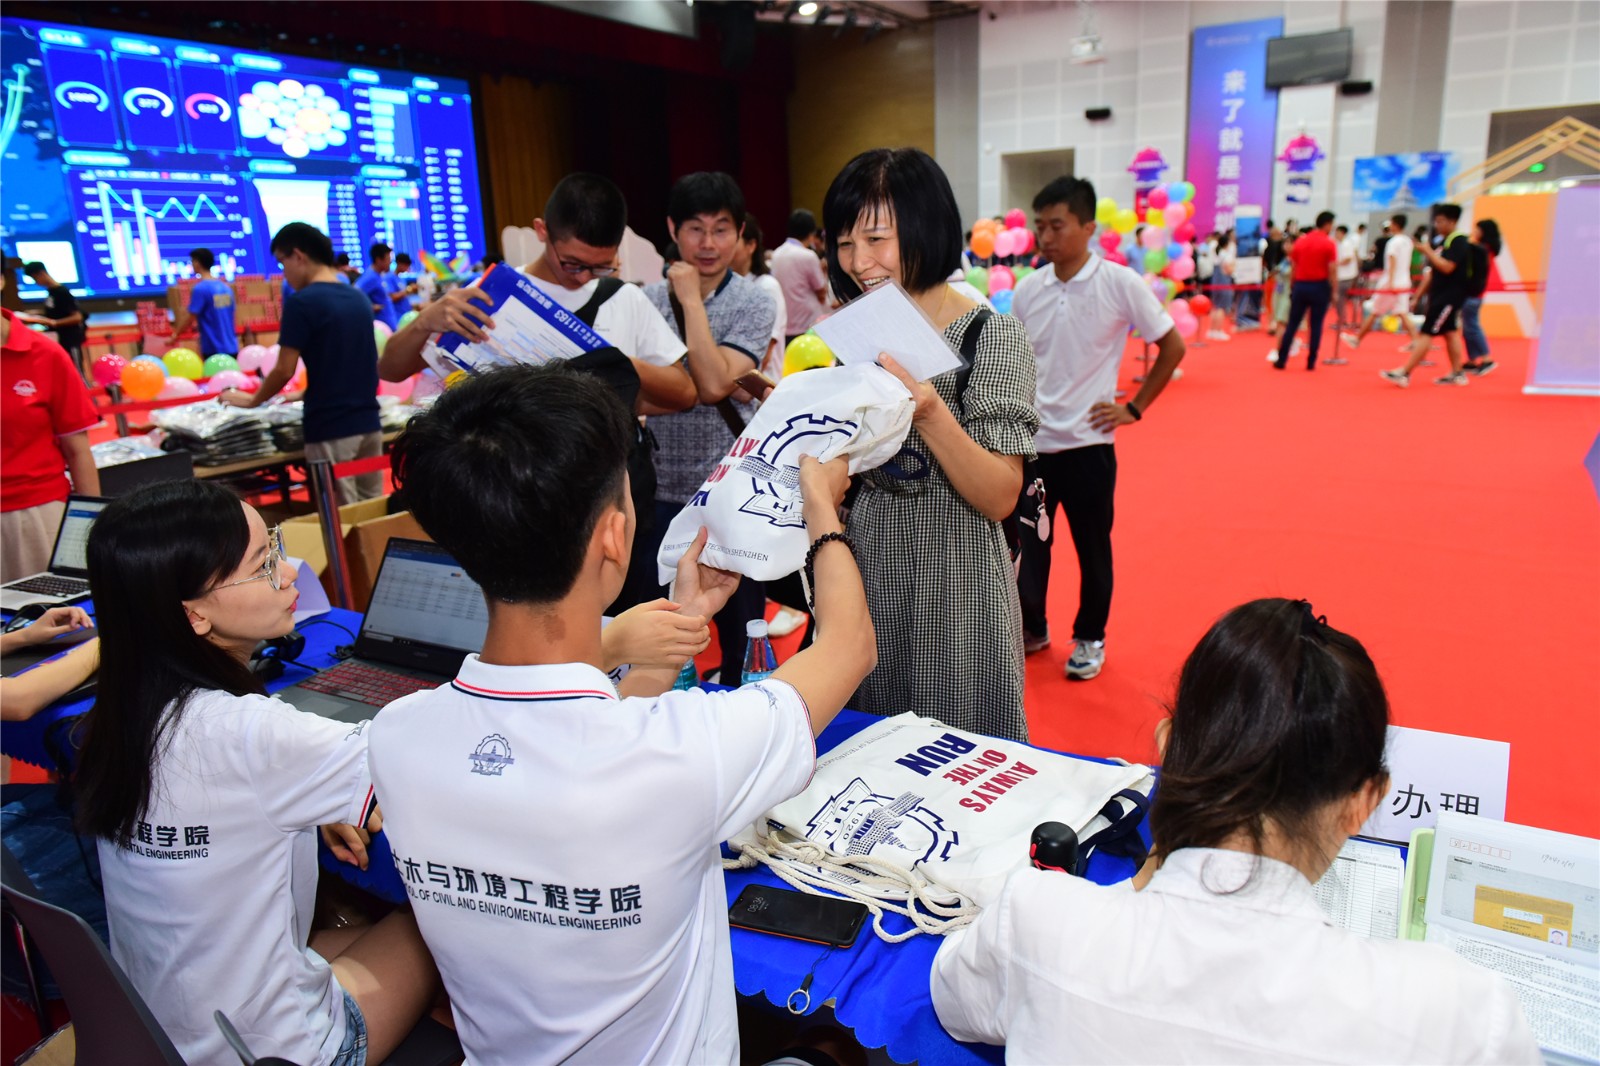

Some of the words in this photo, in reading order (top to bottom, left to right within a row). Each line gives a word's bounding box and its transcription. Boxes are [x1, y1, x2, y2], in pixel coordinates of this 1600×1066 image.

[553, 308, 582, 334] 11183
[731, 548, 769, 561] SHENZHEN
[894, 732, 978, 777] RUN
[973, 749, 1008, 769] ON
[942, 763, 988, 786] THE
[958, 760, 1038, 813] ALWAYS
[132, 821, 210, 847] 程学院
[842, 812, 863, 840] 1920
[146, 848, 209, 860] ENGINEERING
[419, 889, 431, 901] OF
[432, 891, 457, 907] CIVIL
[457, 897, 477, 911] AND
[479, 901, 556, 926] ENVIROMENTAL
[559, 914, 642, 931] ENGINEERING
